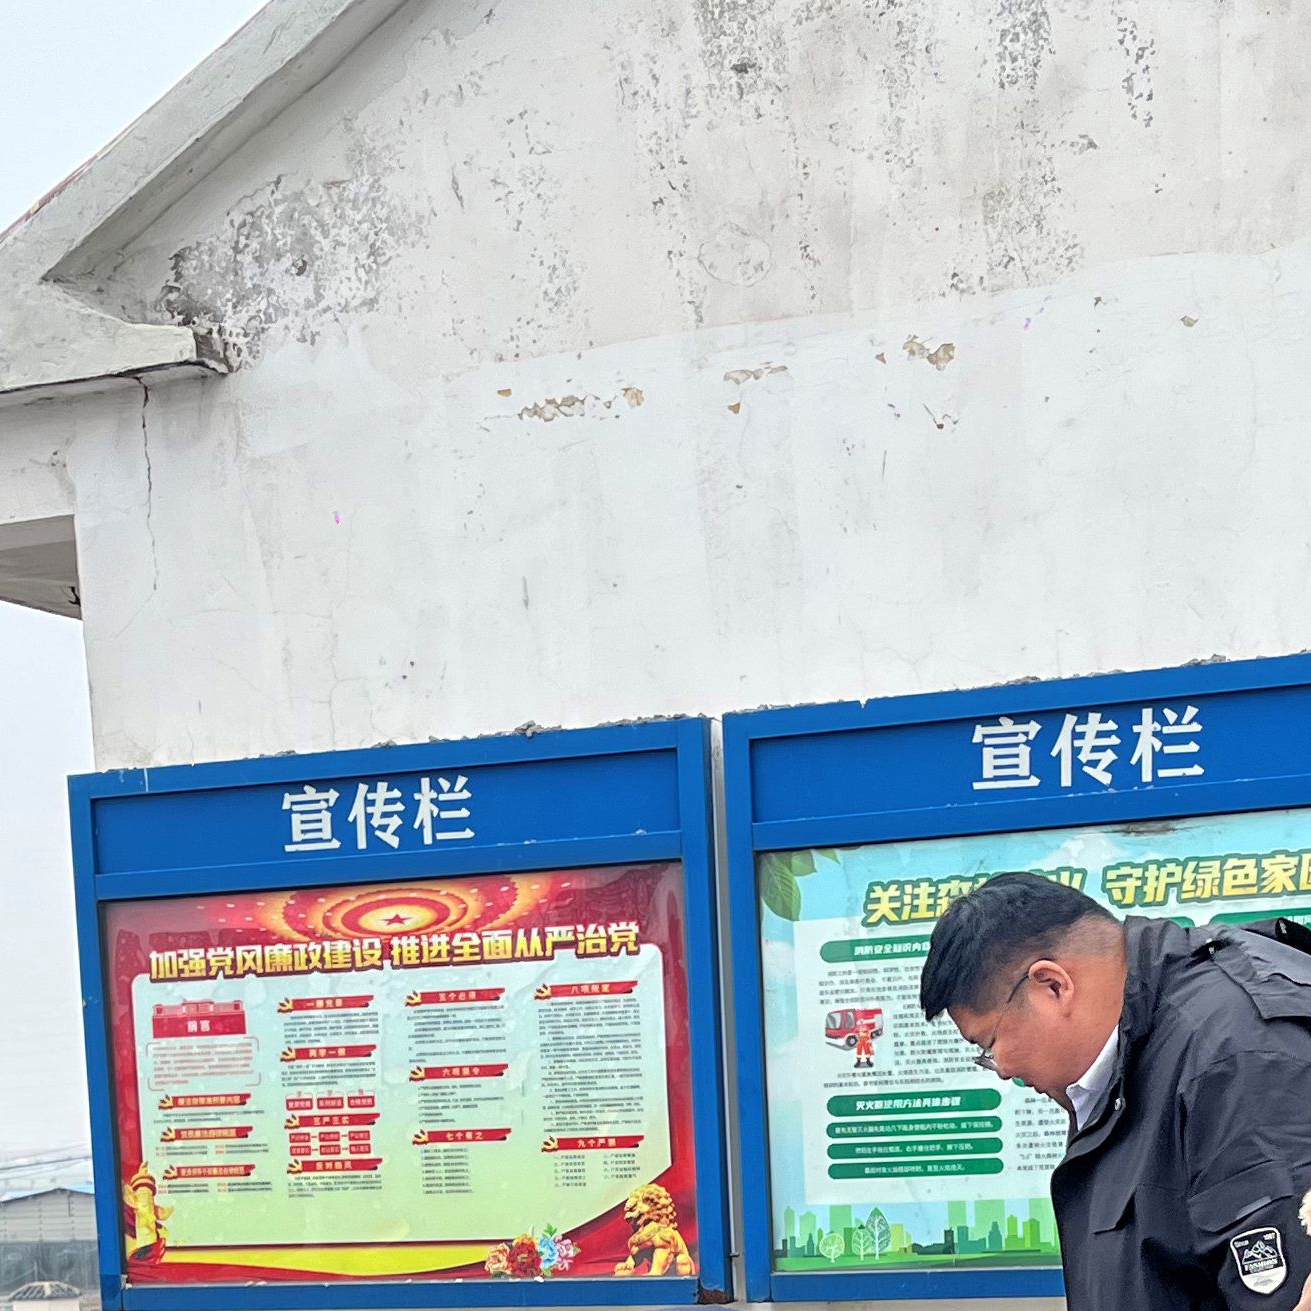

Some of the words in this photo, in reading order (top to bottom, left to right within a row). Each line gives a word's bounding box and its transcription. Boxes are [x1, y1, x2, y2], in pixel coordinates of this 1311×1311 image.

[971, 705, 1206, 791] 宣传栏
[281, 775, 476, 853] 宣传栏
[149, 936, 382, 980] 加强党风廉政建设
[390, 922, 639, 969] 推进全面从严治党
